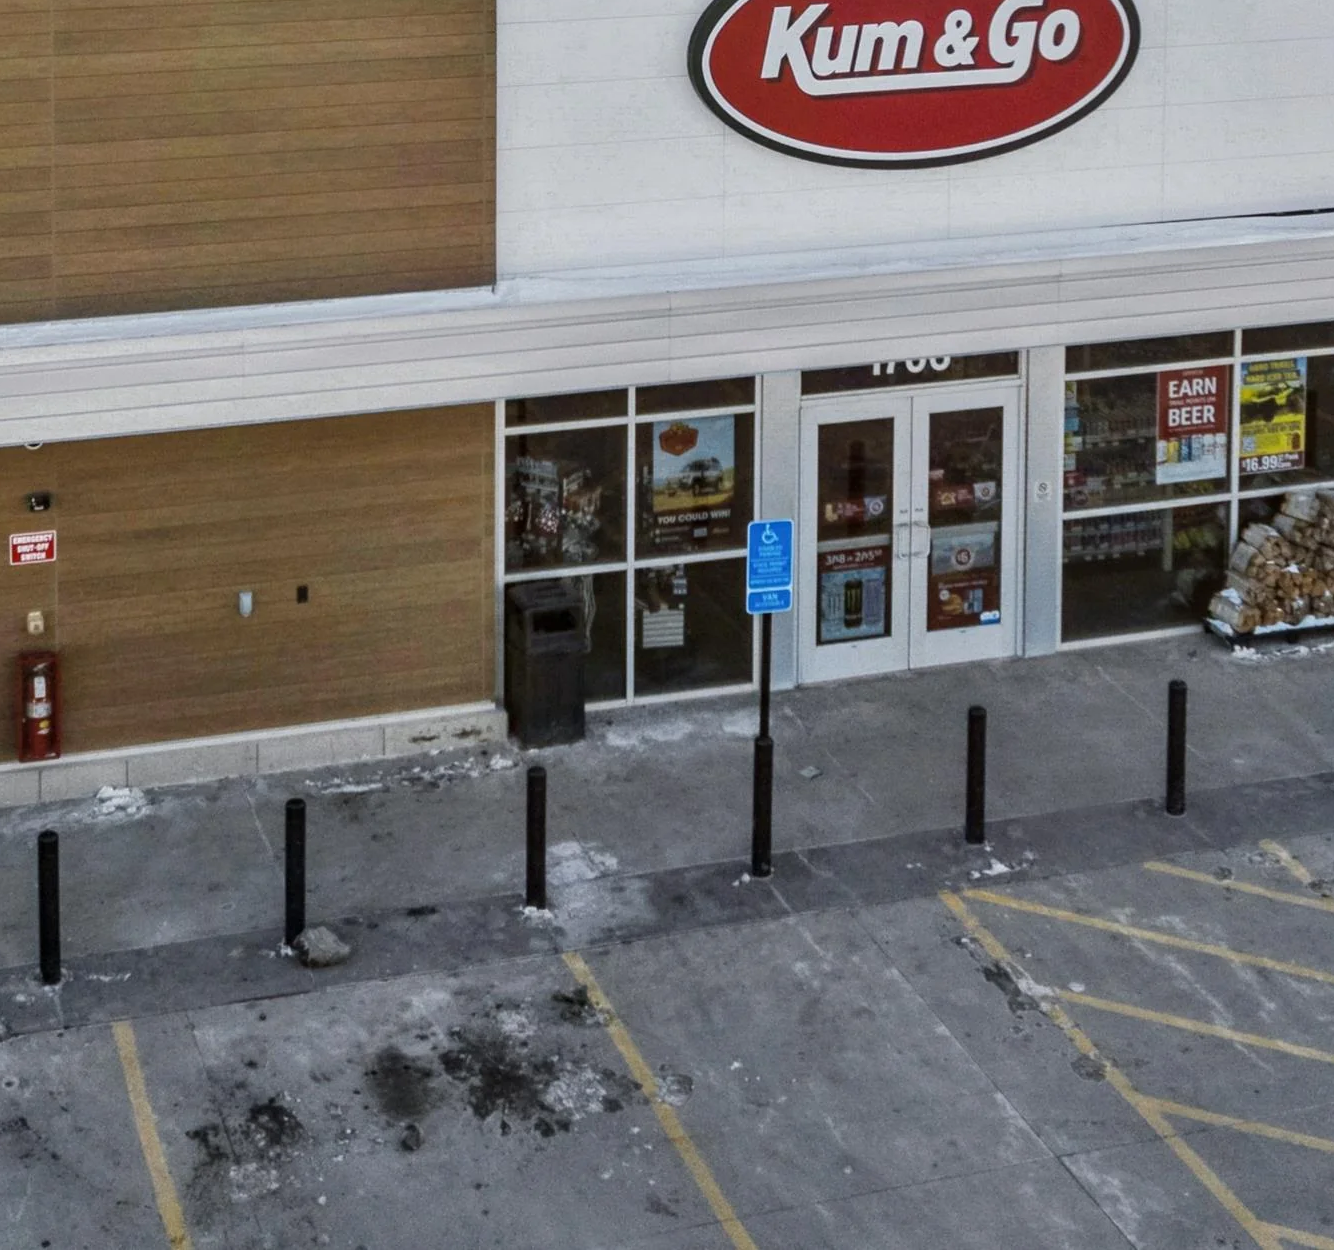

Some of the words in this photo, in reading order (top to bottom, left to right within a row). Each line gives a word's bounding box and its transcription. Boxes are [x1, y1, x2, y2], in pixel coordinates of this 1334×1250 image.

[761, 2, 924, 96] Kum
[933, 8, 979, 68] &
[1168, 377, 1217, 398] EARN
[1168, 405, 1216, 427] BEER
